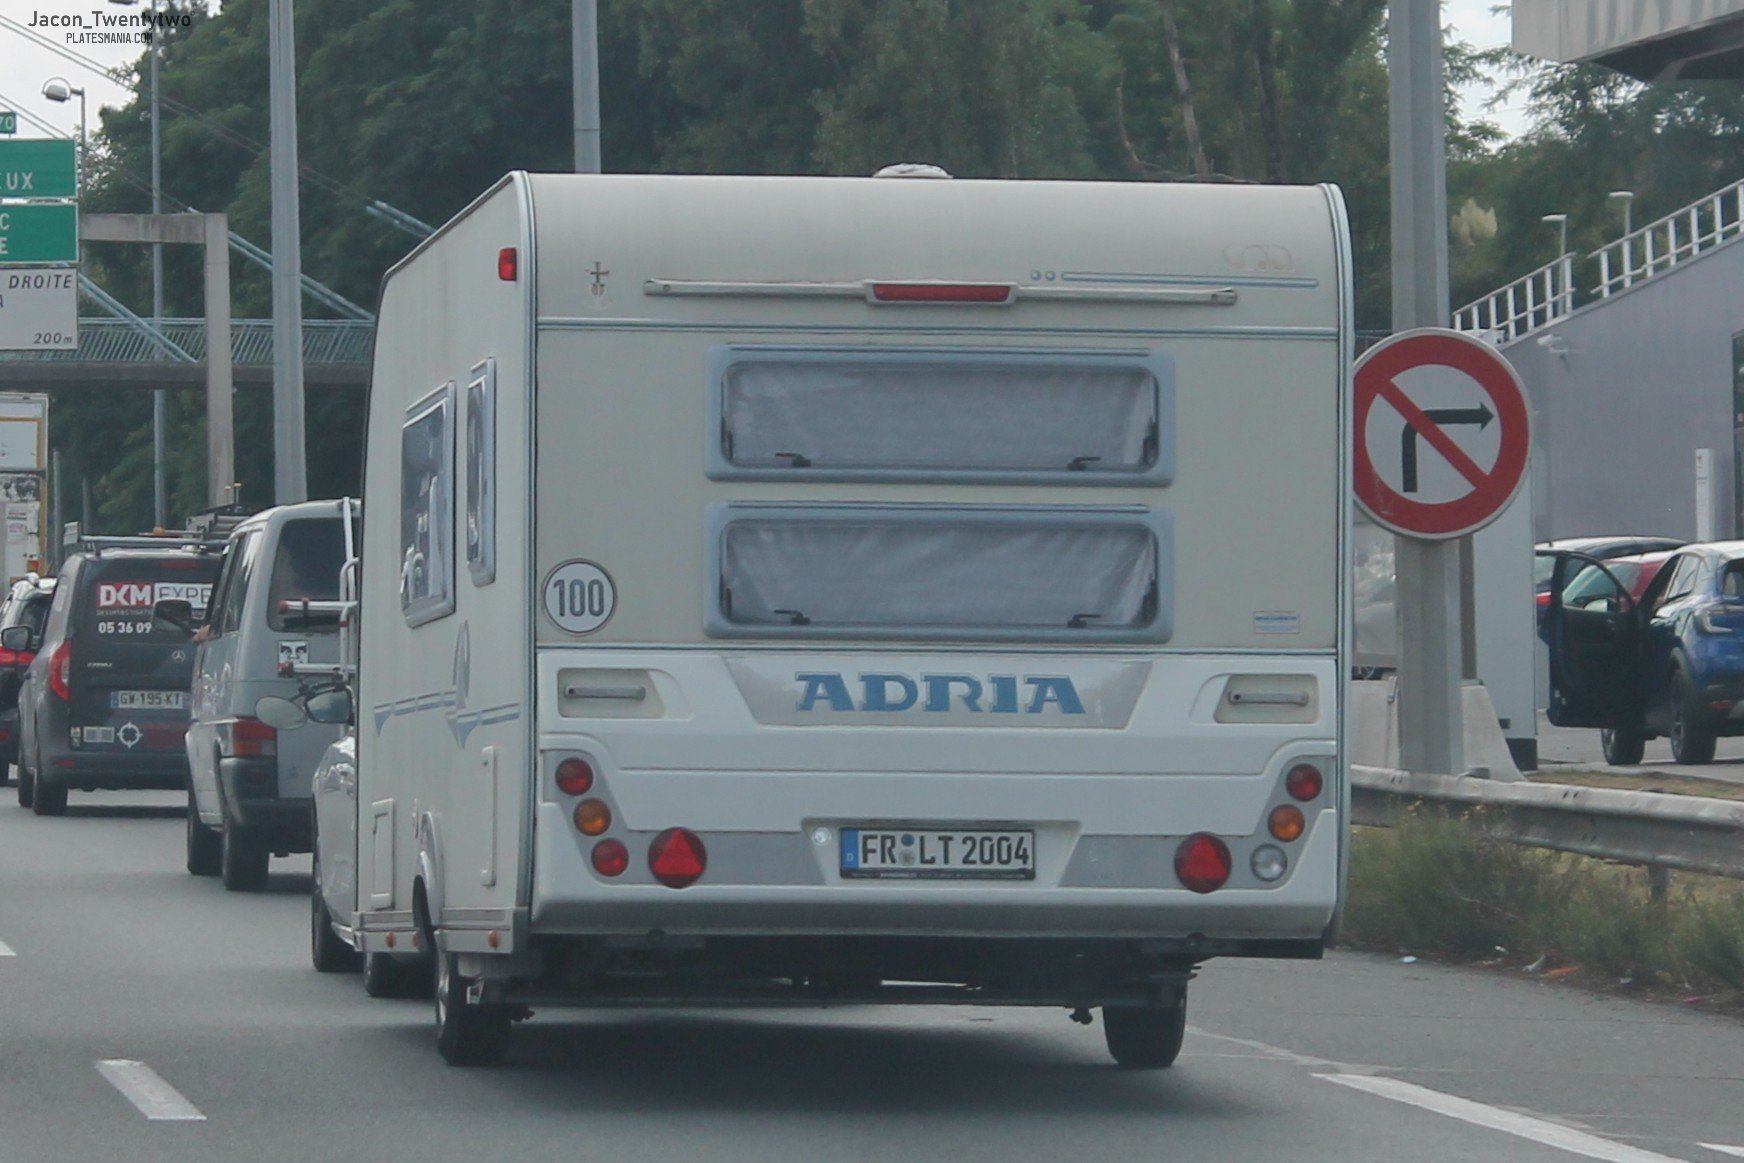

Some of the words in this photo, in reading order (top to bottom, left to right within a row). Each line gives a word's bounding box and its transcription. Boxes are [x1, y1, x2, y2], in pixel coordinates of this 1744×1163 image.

[8, 274, 73, 290] DROITE
[100, 584, 152, 607] DKM
[553, 578, 605, 617] 100
[98, 621, 115, 634] 05
[117, 621, 134, 634] 36
[136, 621, 153, 634] 09
[795, 671, 1086, 714] ADRIA
[861, 834, 897, 864] FR
[919, 835, 955, 865] LT
[961, 835, 1029, 865] 2004
